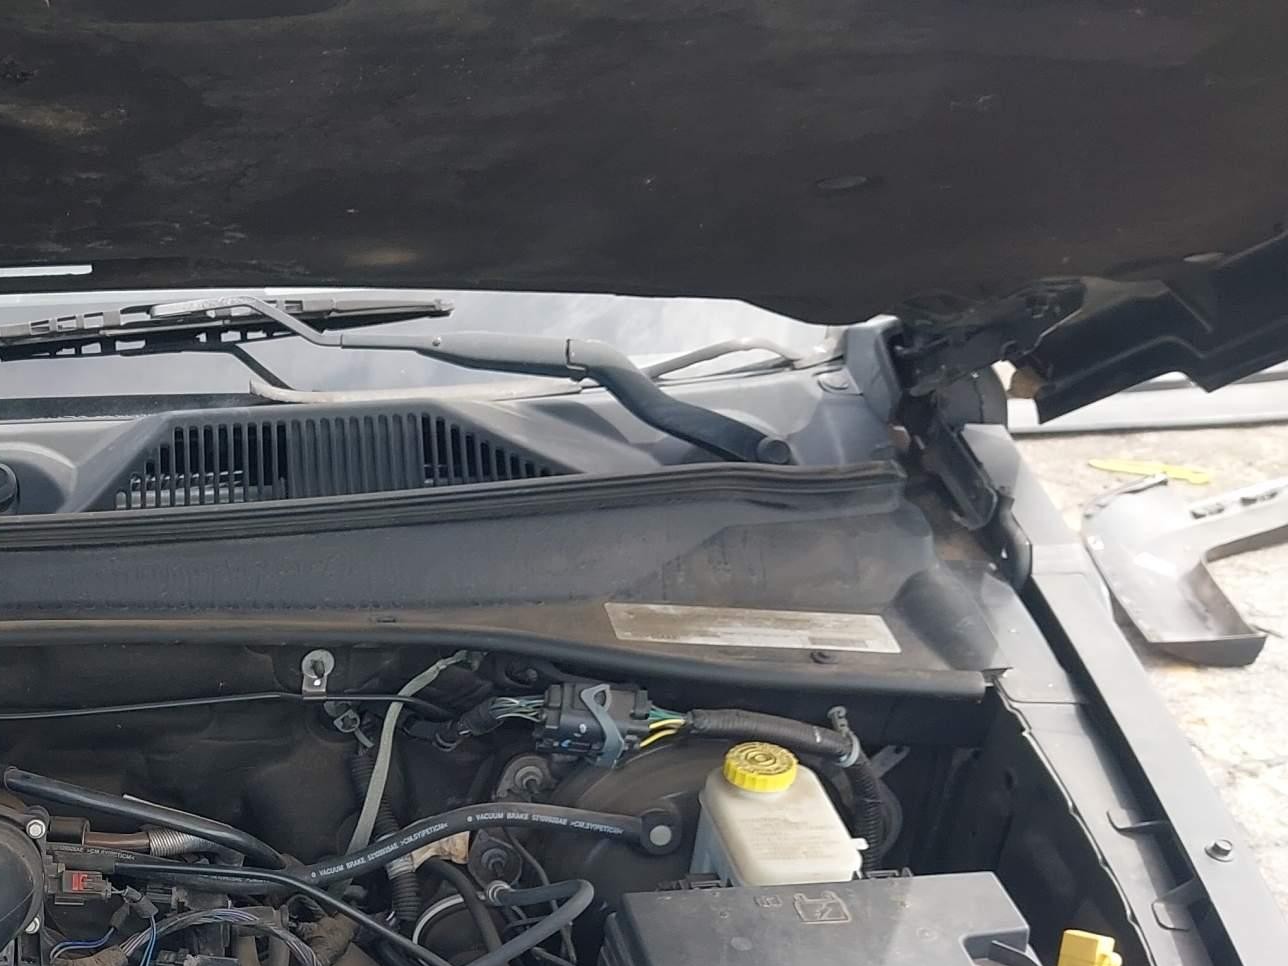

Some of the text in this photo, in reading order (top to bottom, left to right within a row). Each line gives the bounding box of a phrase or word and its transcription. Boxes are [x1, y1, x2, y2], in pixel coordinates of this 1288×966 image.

[476, 812, 504, 822] VACUUM
[507, 811, 529, 821] BRAKE
[318, 864, 344, 877] VACUUM
[346, 856, 367, 870] BRAKE
